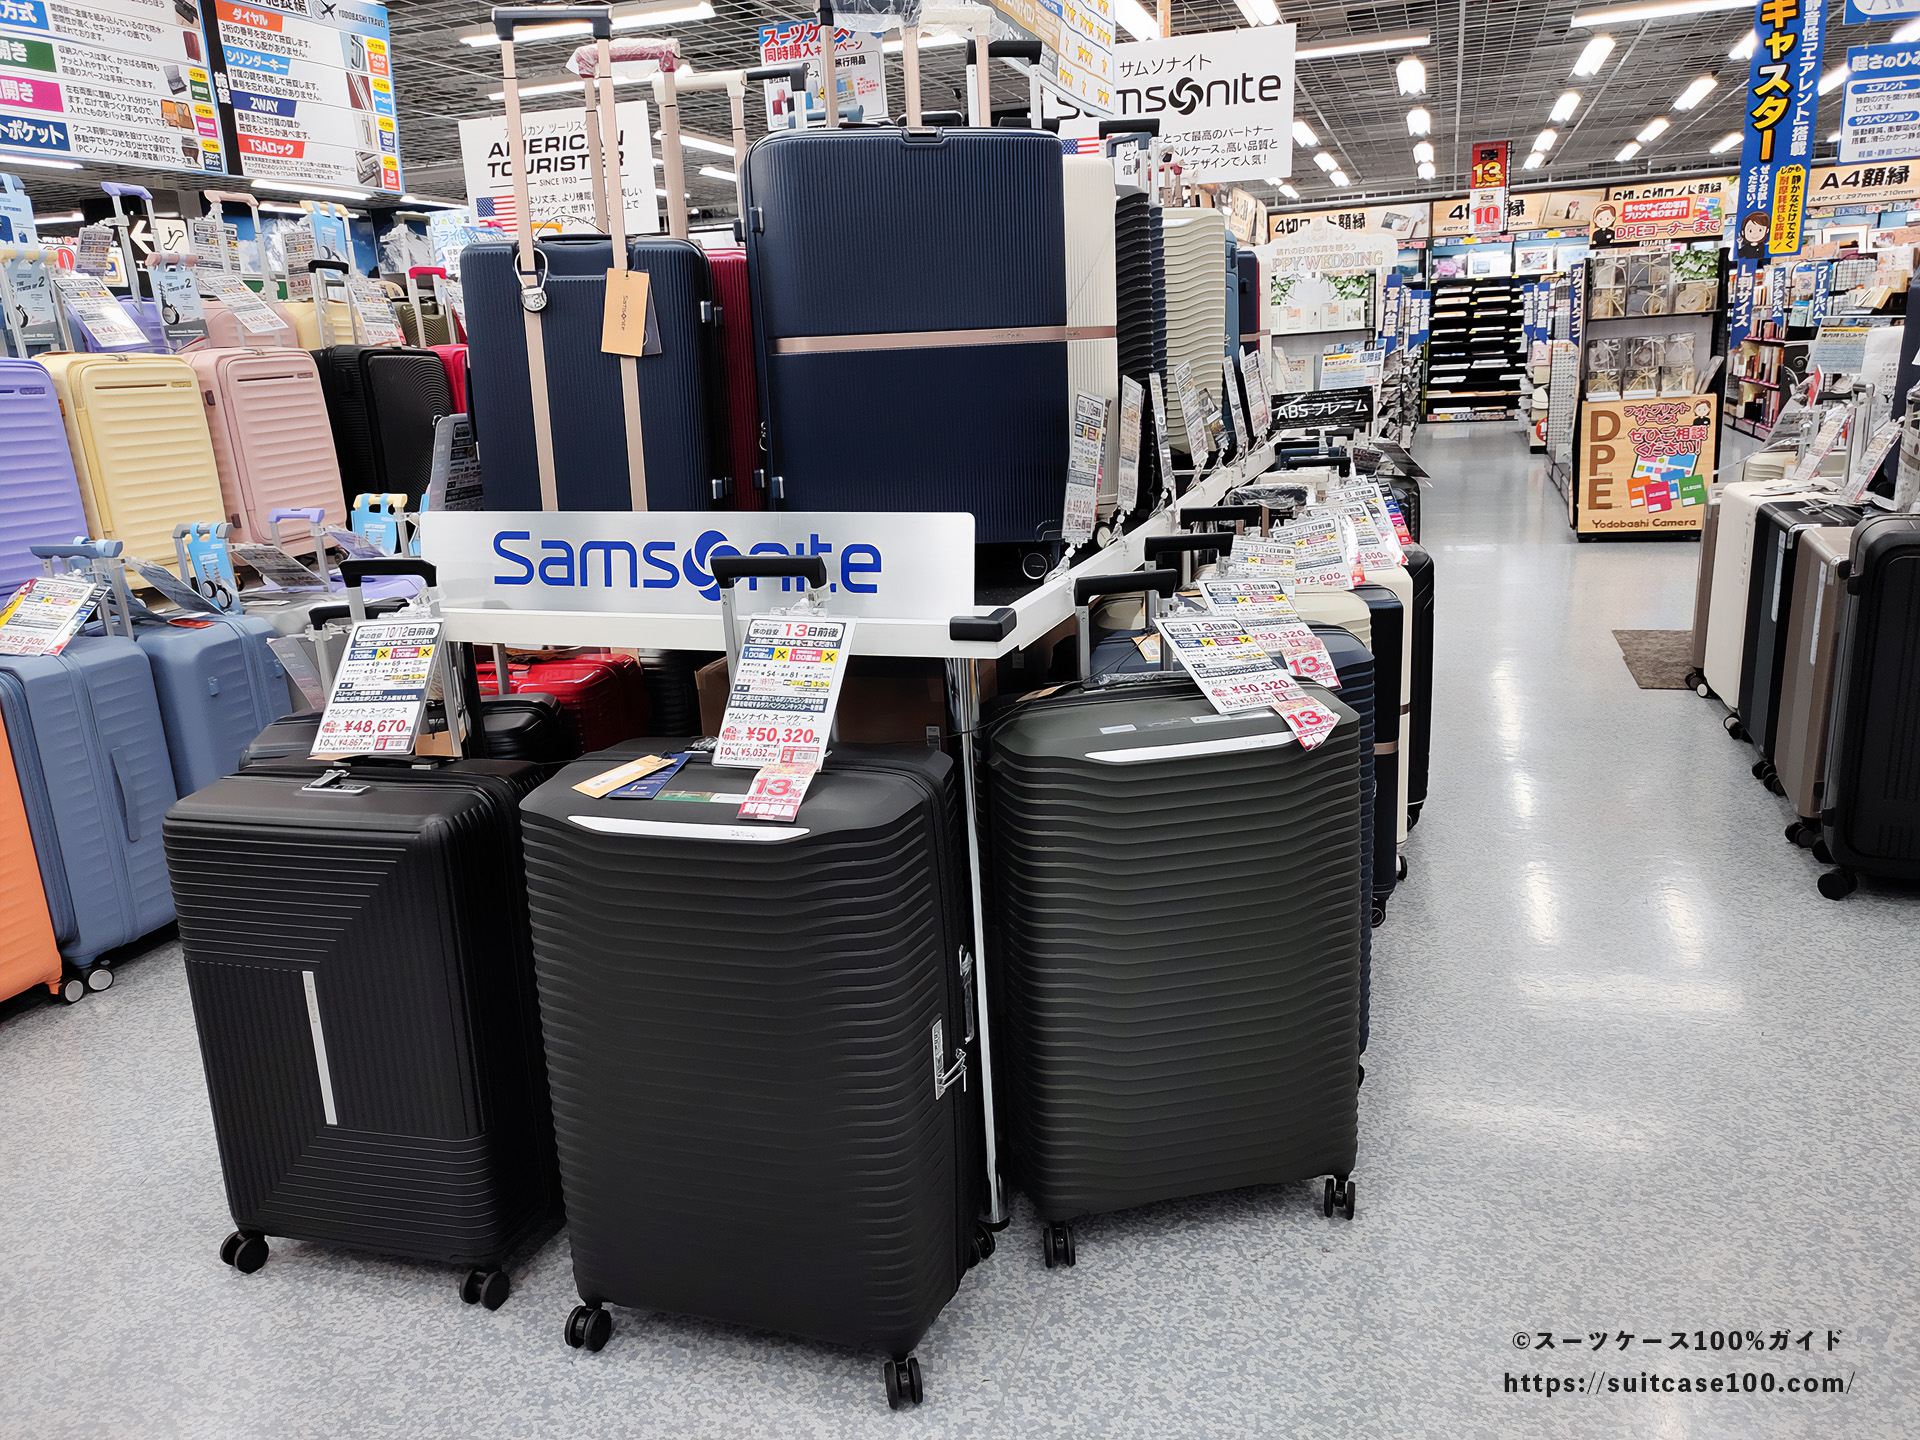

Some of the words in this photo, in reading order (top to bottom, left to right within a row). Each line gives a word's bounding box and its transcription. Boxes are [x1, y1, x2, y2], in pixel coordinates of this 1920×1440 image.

[232, 7, 268, 26] ダイヤル
[226, 50, 289, 71] シリンダーキー
[1119, 53, 1212, 78] サムソナイト
[0, 80, 34, 103] 開き
[1866, 81, 1907, 93] エアレント
[250, 98, 279, 114] 2WAY
[1855, 113, 1914, 126] サスペンション
[248, 138, 294, 156] TSAロック
[1781, 165, 1802, 175] しかも
[1820, 165, 1910, 190] A4額縁
[540, 179, 560, 187] SINCE
[562, 176, 578, 185] 1933
[1785, 175, 1801, 249] 静かなだけでなく
[1615, 220, 1720, 239] DPEコーナーまで
[1813, 265, 1829, 319] フリーアルバム
[1276, 403, 1309, 420] ABS
[1624, 402, 1691, 418] フォトプリント
[1636, 413, 1678, 427] サービス
[1592, 518, 1650, 529] Yodobashi
[1652, 518, 1697, 527] Camera
[785, 623, 839, 638] 13日前後
[789, 671, 799, 679] 81
[728, 712, 769, 721] サムソナイト
[771, 713, 815, 722] スーツケース
